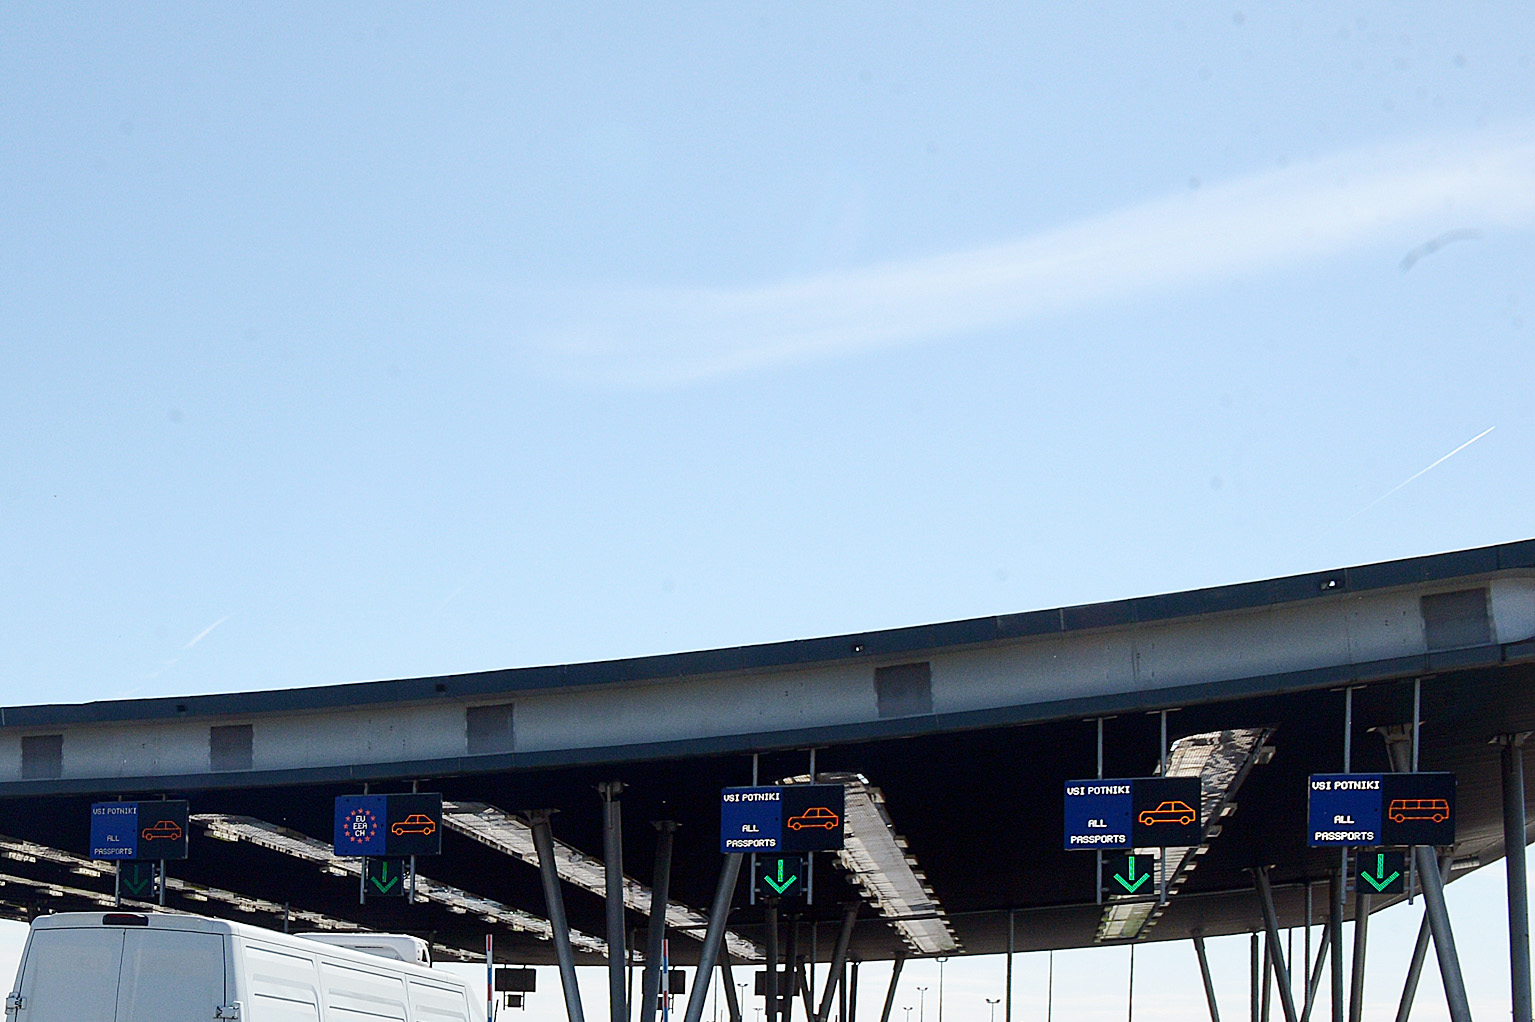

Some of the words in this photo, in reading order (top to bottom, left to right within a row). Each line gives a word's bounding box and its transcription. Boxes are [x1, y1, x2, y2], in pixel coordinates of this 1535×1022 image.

[1312, 781, 1331, 790] VSI
[1334, 780, 1379, 790] POTNIKI
[1066, 787, 1085, 796] VSI
[1087, 785, 1131, 795] POTNIKI
[723, 794, 740, 802] VSI
[741, 792, 780, 802] POTNIKI
[107, 807, 137, 815] POTNIKI
[1087, 819, 1108, 828] ALL
[1333, 815, 1355, 824] ALL
[352, 822, 368, 830] EEA
[741, 824, 760, 832] ALL
[354, 829, 366, 837] CH
[1314, 831, 1375, 841] PASSPORTS
[106, 834, 120, 842] ALL
[1070, 834, 1126, 844] PASSPORTS
[726, 838, 777, 848] PASSPORTS
[94, 847, 133, 855] PASSPORTS
